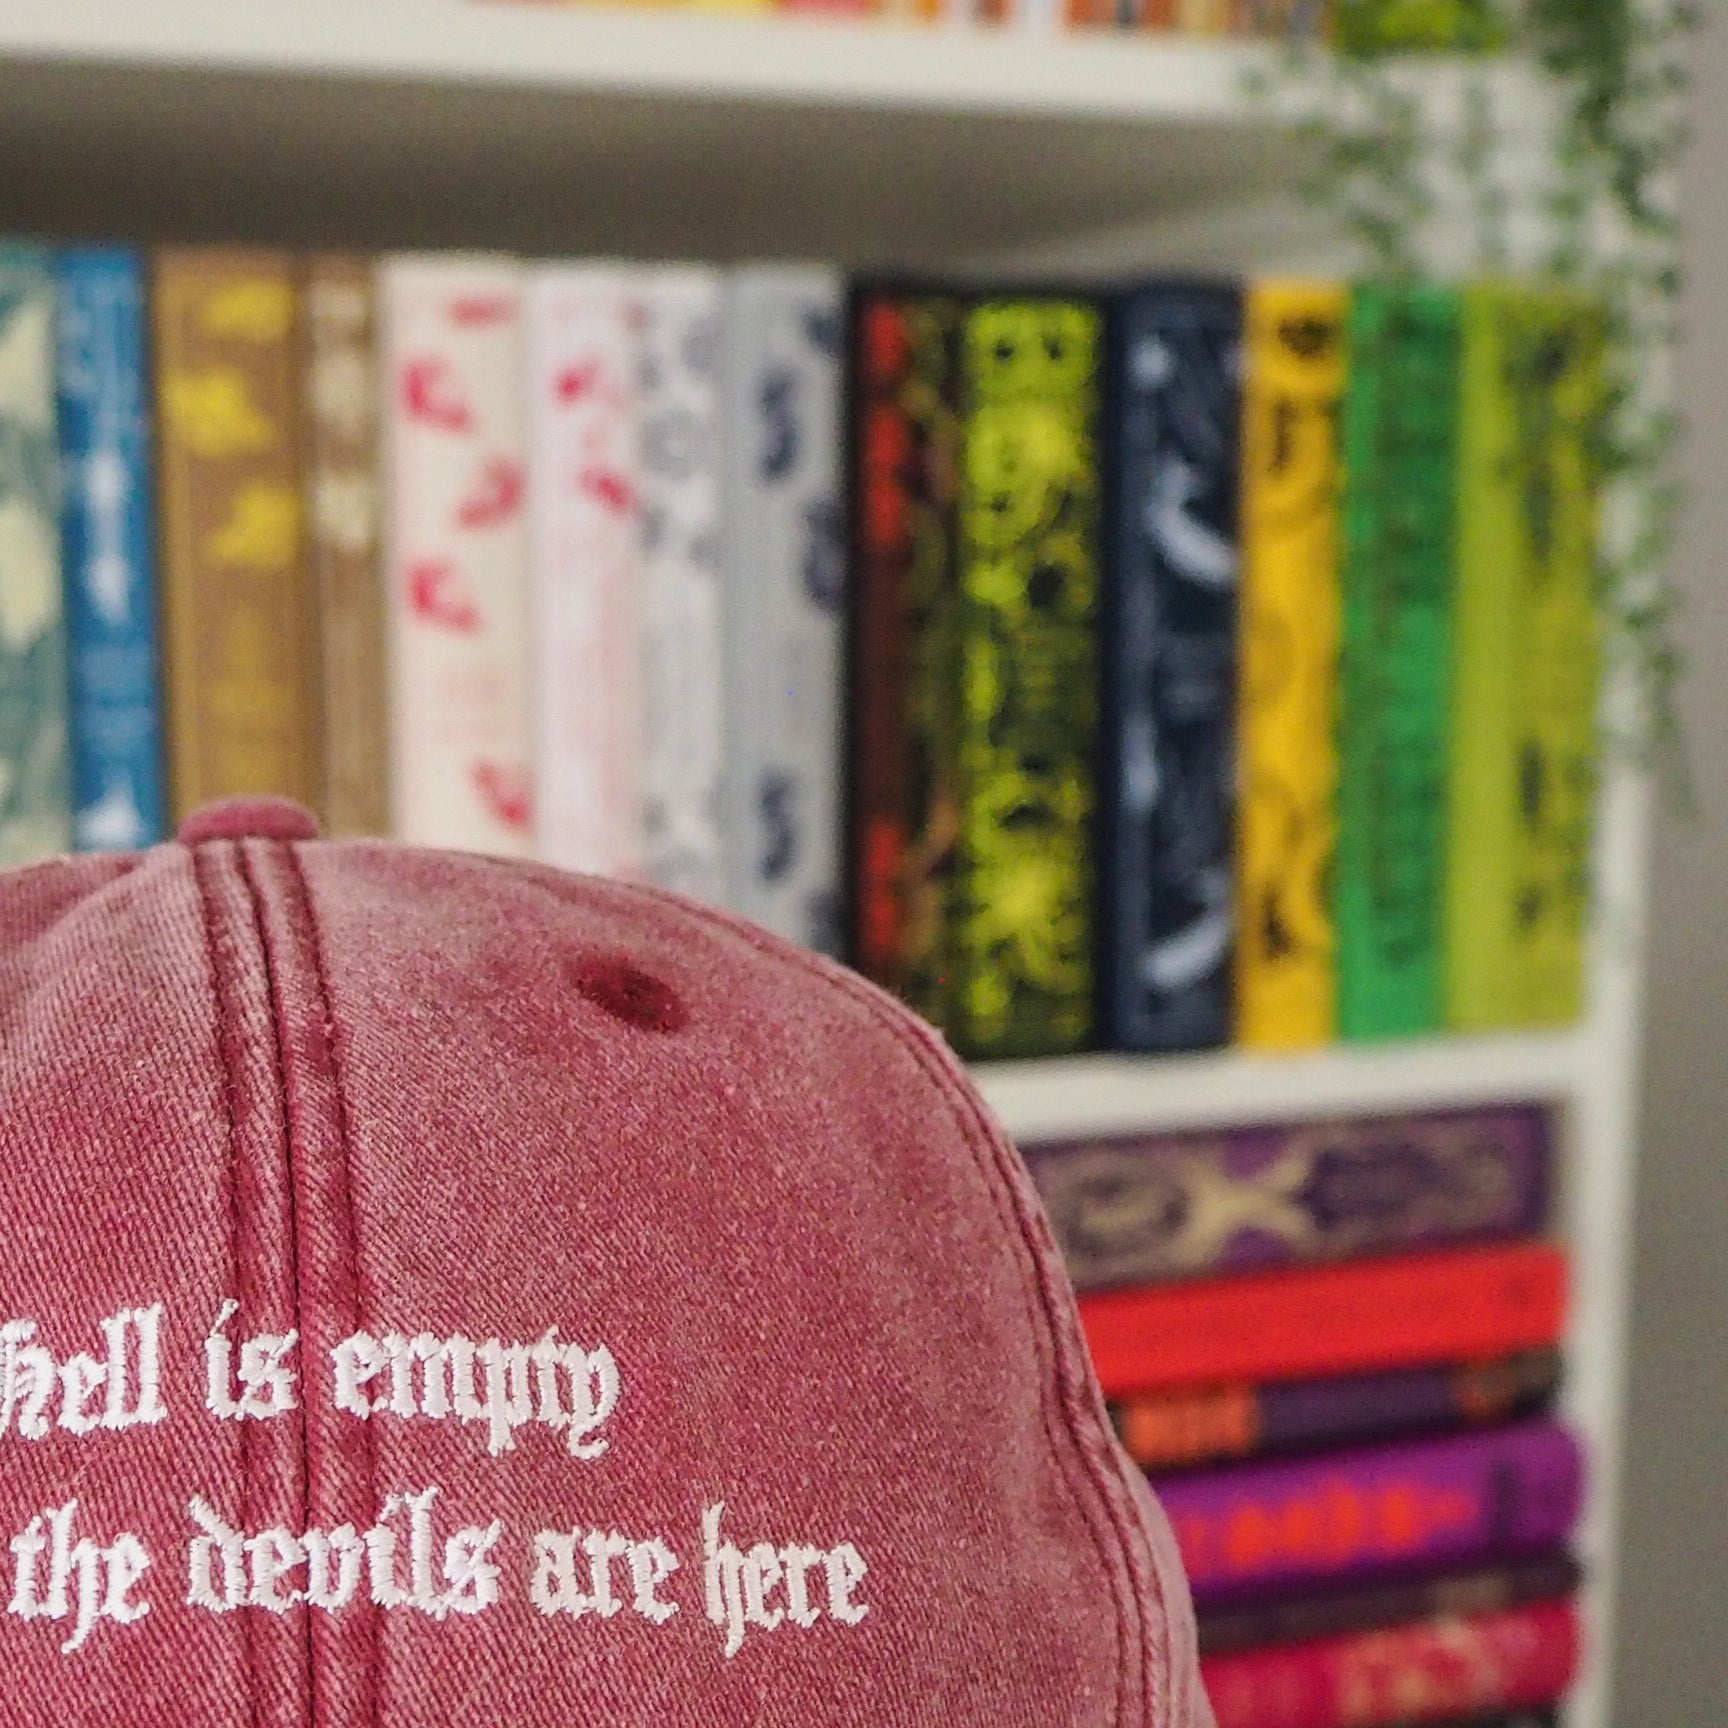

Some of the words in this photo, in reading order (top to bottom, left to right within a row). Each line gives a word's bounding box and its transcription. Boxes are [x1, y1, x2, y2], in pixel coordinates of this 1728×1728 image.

[204, 1297, 298, 1421] is
[328, 1324, 620, 1460] empty
[6, 1497, 151, 1655] the
[185, 1484, 502, 1621] devils
[529, 1525, 680, 1625] are
[701, 1500, 870, 1658] here
